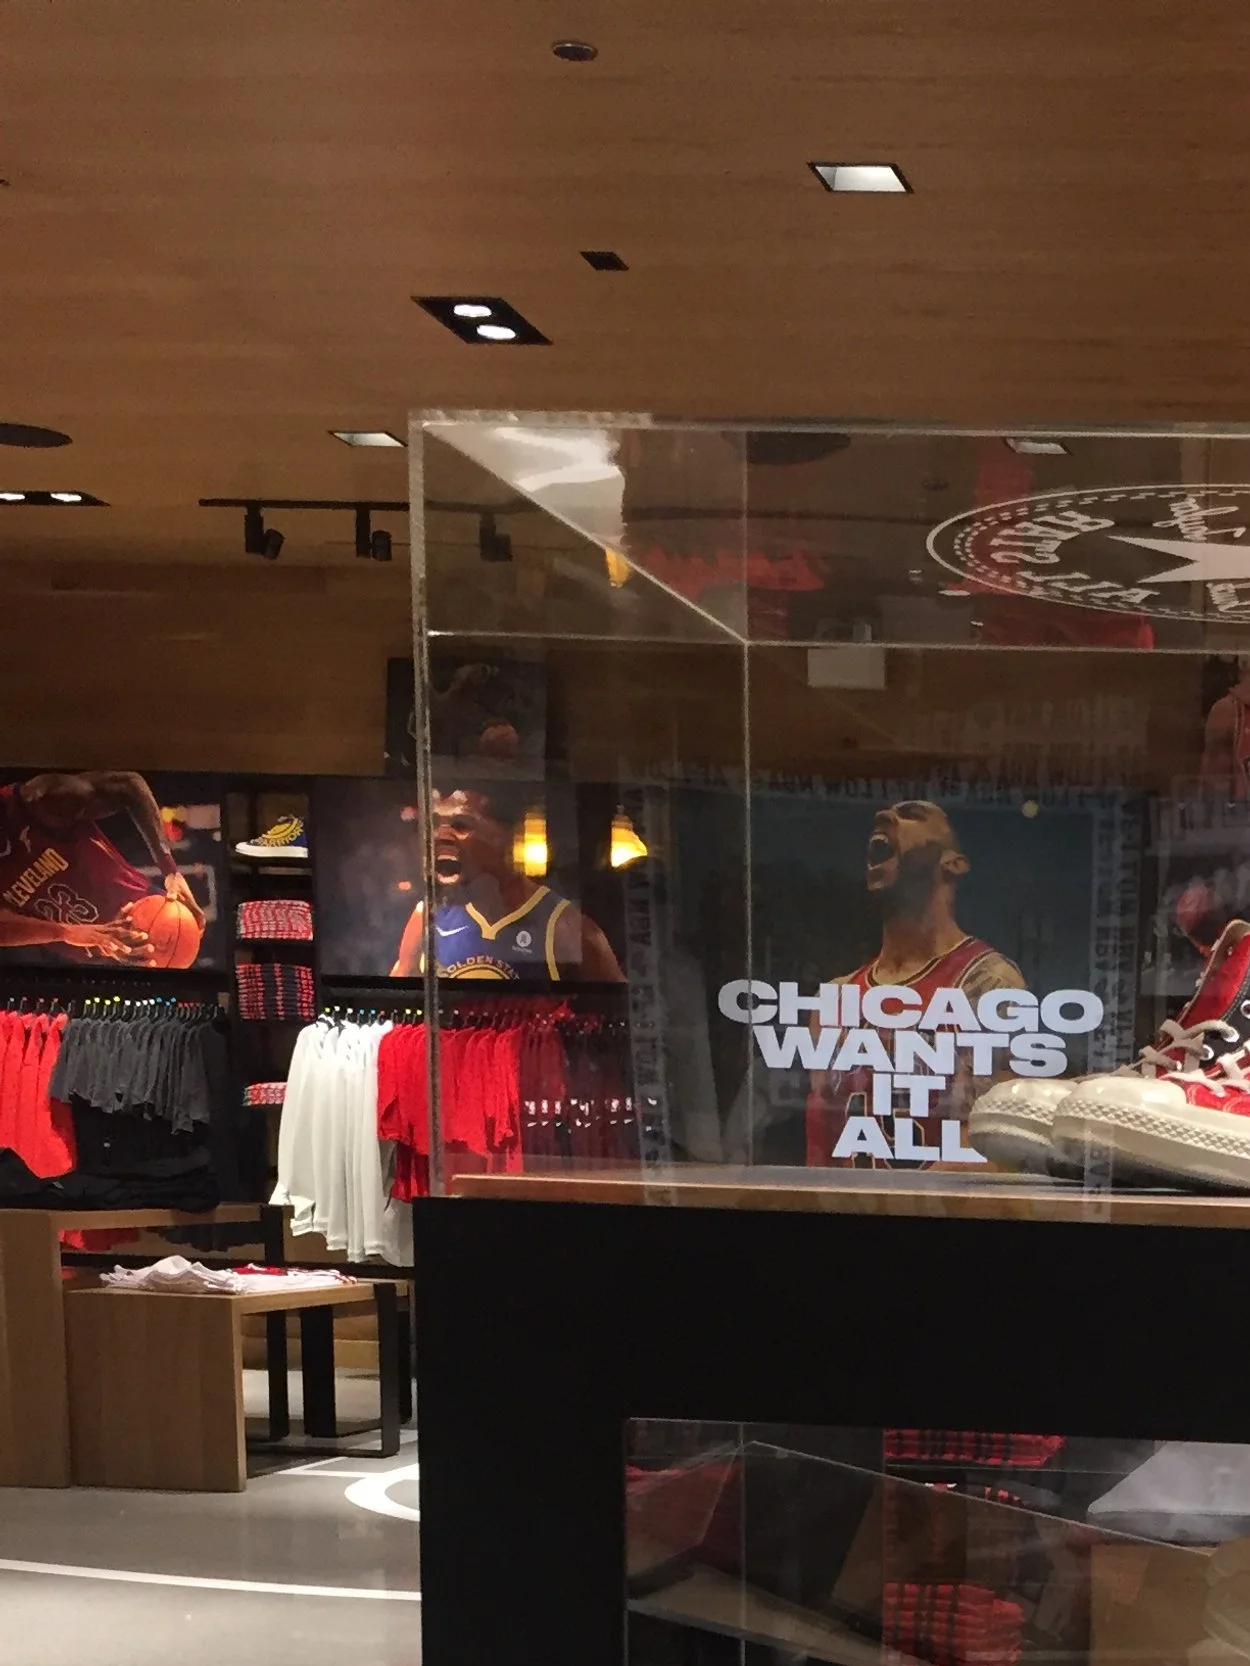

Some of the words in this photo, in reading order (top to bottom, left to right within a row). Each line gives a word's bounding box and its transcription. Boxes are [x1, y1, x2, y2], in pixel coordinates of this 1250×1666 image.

[718, 979, 1104, 1034] CHICAGO
[753, 1026, 1068, 1077] WANTS
[873, 1073, 946, 1117] IT
[831, 1116, 988, 1163] ALL
